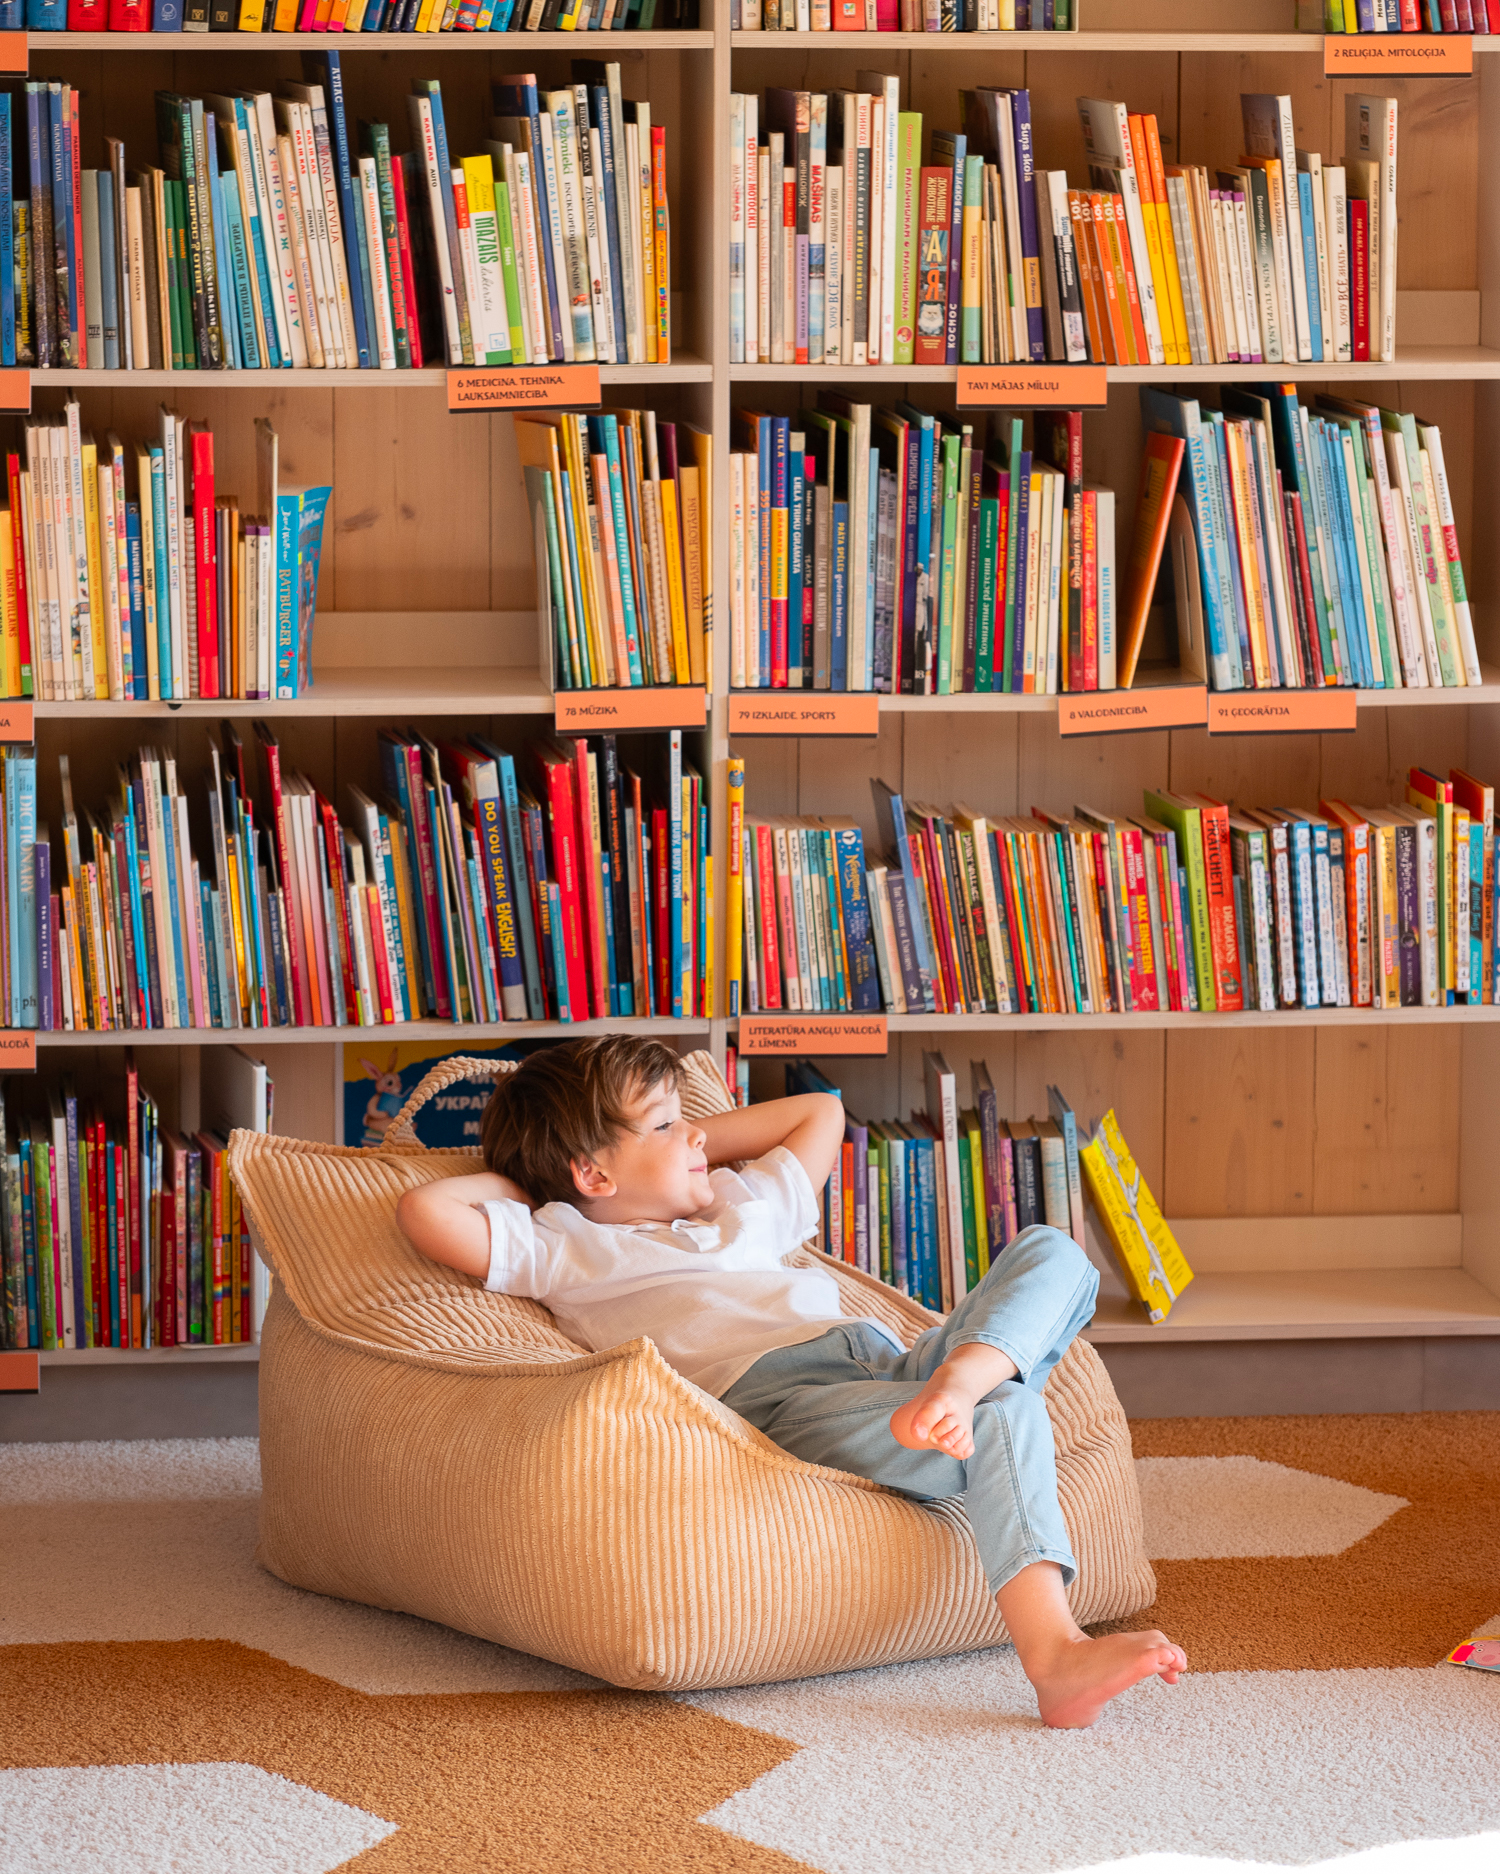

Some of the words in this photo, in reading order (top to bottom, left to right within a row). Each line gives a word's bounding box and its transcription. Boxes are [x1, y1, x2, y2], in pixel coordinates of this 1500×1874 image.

[1333, 49, 1340, 57] 2
[1387, 48, 1446, 59] MITOLOĢIJA
[332, 67, 344, 103] АТЛАС
[600, 96, 612, 156] Makšķerēšanas
[1019, 123, 1032, 151] Suņa
[1283, 115, 1295, 147] ZIRGI
[182, 114, 195, 178] ЖИВОТНЫЕ
[298, 148, 304, 157] IR
[545, 148, 553, 160] KĀ
[559, 119, 574, 175] Dzīvnieki
[747, 137, 756, 156] 101
[1123, 142, 1130, 151] IR
[1125, 153, 1133, 168] KAS
[1286, 152, 1296, 169] UN
[0, 145, 9, 183] BRĪNUMI
[299, 159, 307, 174] KAS
[319, 145, 331, 184] MANA
[425, 136, 433, 144] IR
[430, 169, 438, 187] AUTO
[605, 158, 613, 173] ABC
[1022, 153, 1033, 182] skola
[1, 185, 8, 198] UN
[268, 148, 289, 250] ЖИВОТНЫХ
[308, 149, 314, 157] IR
[317, 209, 326, 240] ZIRNEKĻI
[547, 168, 556, 202] RODAS
[811, 165, 823, 223] MAŠĪNAS
[925, 177, 937, 222] ЖИВОТНЫЕ
[935, 177, 947, 222] ДОМАШНИЕ
[1129, 176, 1137, 194] ZIRGI
[188, 185, 199, 239] ВОПРОС
[324, 189, 340, 244] LATVIJA
[564, 182, 579, 248] ENCIKLOPĒDIJA
[748, 183, 756, 228] MOTOCIKLI
[1071, 199, 1080, 220] 101
[1082, 201, 1091, 221] 101
[1094, 203, 1103, 221] 101
[1104, 201, 1113, 221] 101
[1116, 203, 1124, 220] 101
[1, 201, 10, 251] NOSLĒPUMI
[306, 209, 315, 240] ZIRNEKĻI
[551, 209, 562, 247] BĒRNI?
[233, 223, 246, 271] КВАРТИРЕ
[475, 217, 499, 264] MAZAIS
[503, 247, 513, 265] Sēnes
[569, 250, 581, 289] BĒRNIEM
[948, 304, 957, 348] КОСМОС
[954, 176, 962, 205] ВОКРУГ
[193, 253, 203, 295] ОТВЕТ
[240, 283, 253, 318] ПТИЦЫ
[284, 269, 300, 328] АТЛАС
[245, 332, 256, 362] РЫБЫ
[457, 380, 464, 388] 6
[457, 390, 548, 401] LAUKSAIMNIECĪBA
[967, 382, 989, 390] TAVI
[990, 379, 1024, 390] MĀJAS
[1027, 379, 1059, 392] MĪLUĻI
[1291, 410, 1300, 442] ATLANTS
[908, 443, 919, 490] OLIMPISKĀS
[793, 477, 803, 501] LIELĀ
[614, 493, 624, 528] MŪZIKAS
[793, 503, 802, 529] TRIKU
[907, 496, 918, 524] SPĒLES
[1383, 496, 1393, 521] SENĀ
[837, 523, 846, 544] PRĀTA
[1387, 524, 1398, 561] JAPĀNA
[1421, 525, 1430, 554] Mana
[1444, 529, 1458, 557] TAVS
[618, 533, 628, 568] VĒSTURE
[792, 532, 804, 573] GRĀMATA
[837, 546, 846, 572] SPĒLES
[6, 569, 15, 597] MANGA
[1102, 567, 1113, 586] MAZĀ
[1425, 557, 1437, 584] māja
[1450, 565, 1464, 597] SUNS
[623, 575, 632, 611] BĒRNIEM
[835, 574, 844, 604] gudriem
[1102, 589, 1111, 619] VALODAS
[8, 600, 17, 638] VILLAINS
[279, 569, 292, 646] RATBURGER
[835, 606, 845, 637] bērniem
[1102, 622, 1112, 654] GRĀMATA
[565, 707, 577, 716] 78
[579, 704, 618, 716] MŪZIKA
[738, 711, 750, 719] 79
[800, 711, 836, 720] SPORTS
[1069, 711, 1076, 720] 8
[1077, 706, 1148, 719] VALODNIECĪBA
[1218, 708, 1228, 716] 91
[1231, 705, 1290, 718] ĢEOGRĀFIJA
[484, 802, 496, 821] DO
[19, 795, 34, 895] DICTIONARY
[488, 825, 499, 853] YOU
[672, 822, 681, 847] BUSY,
[672, 850, 681, 868] BUSY
[1126, 844, 1136, 889] PATTERSON
[1135, 853, 1143, 879] JAMES
[1207, 819, 1223, 897] PRATCHETT
[492, 858, 506, 900] SPEAK
[539, 881, 548, 901] EASY
[673, 870, 681, 898] TOWN
[541, 904, 551, 934] STREET
[1136, 895, 1147, 921] MAX
[496, 903, 516, 958] ENGLISH?
[1223, 906, 1235, 963] DRAGONS
[1139, 923, 1153, 974] EINSTEIN
[748, 1024, 805, 1035] LITERATŪRA
[807, 1026, 842, 1037] ANGĻU
[843, 1024, 882, 1035] VALODĀ
[748, 1039, 756, 1048] 2.
[758, 1038, 797, 1048] LĪMENIS
[435, 1091, 494, 1110] УКРАЇ
[1096, 1173, 1133, 1253] Winnie-the-Pooh
